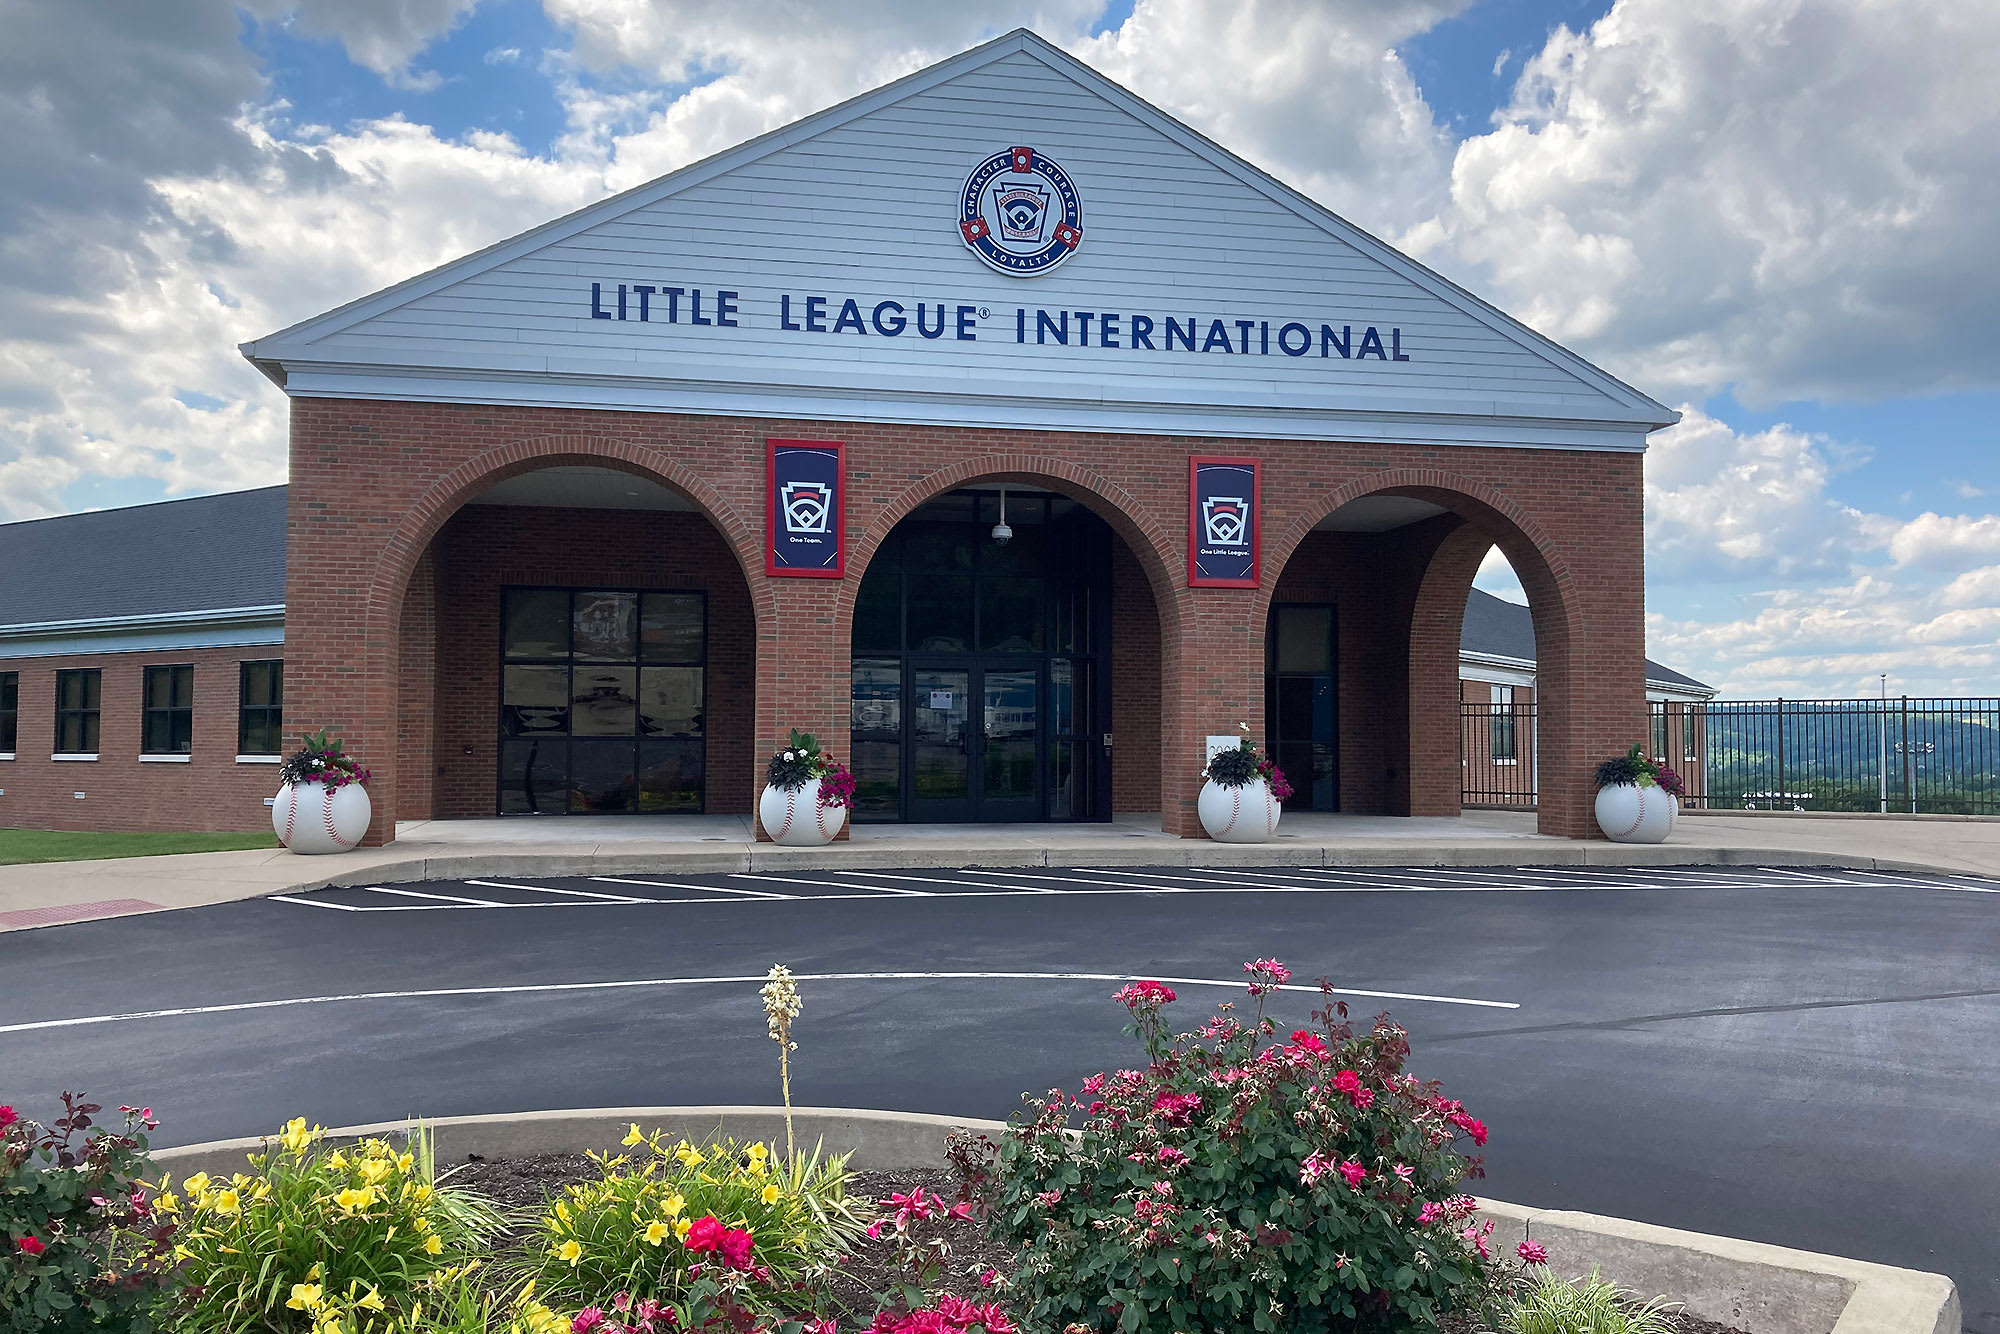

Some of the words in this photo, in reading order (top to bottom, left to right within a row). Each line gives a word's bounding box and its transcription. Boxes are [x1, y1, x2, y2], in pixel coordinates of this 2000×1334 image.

[967, 158, 1007, 215] CHARACTER
[1038, 161, 1076, 218] COURAGE
[991, 249, 1050, 267] LOYALTY
[591, 282, 739, 328] LITTLE
[1016, 308, 1410, 362] INTERNATIONAL
